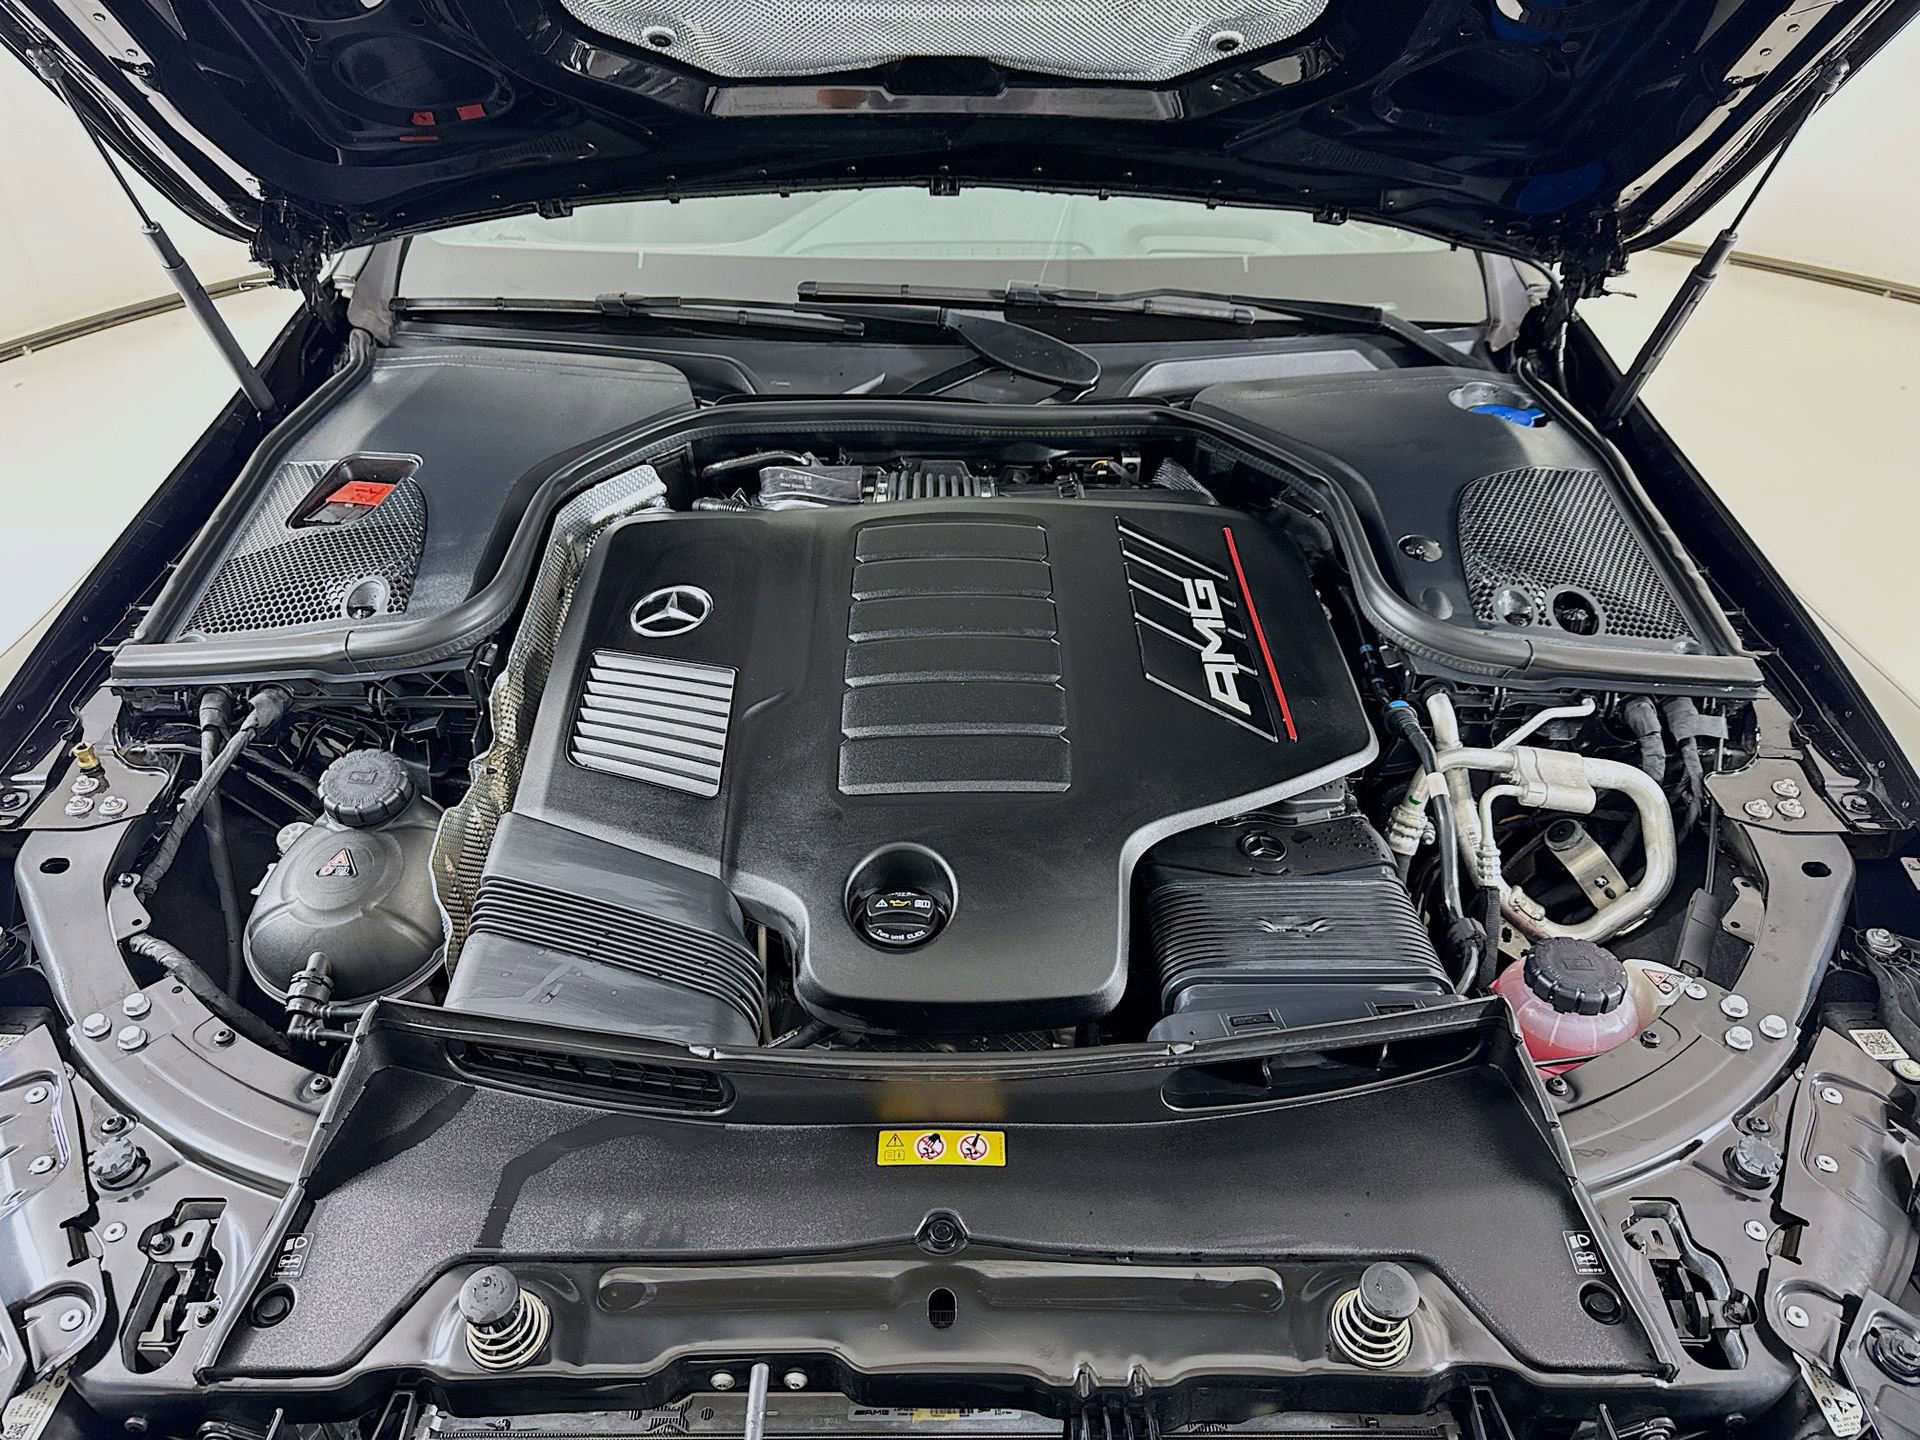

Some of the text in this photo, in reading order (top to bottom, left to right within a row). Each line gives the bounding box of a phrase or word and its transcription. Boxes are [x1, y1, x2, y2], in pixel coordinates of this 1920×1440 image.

[1182, 578, 1251, 715] AMG
[876, 929, 890, 939] Turn
[906, 930, 925, 940] CLICK
